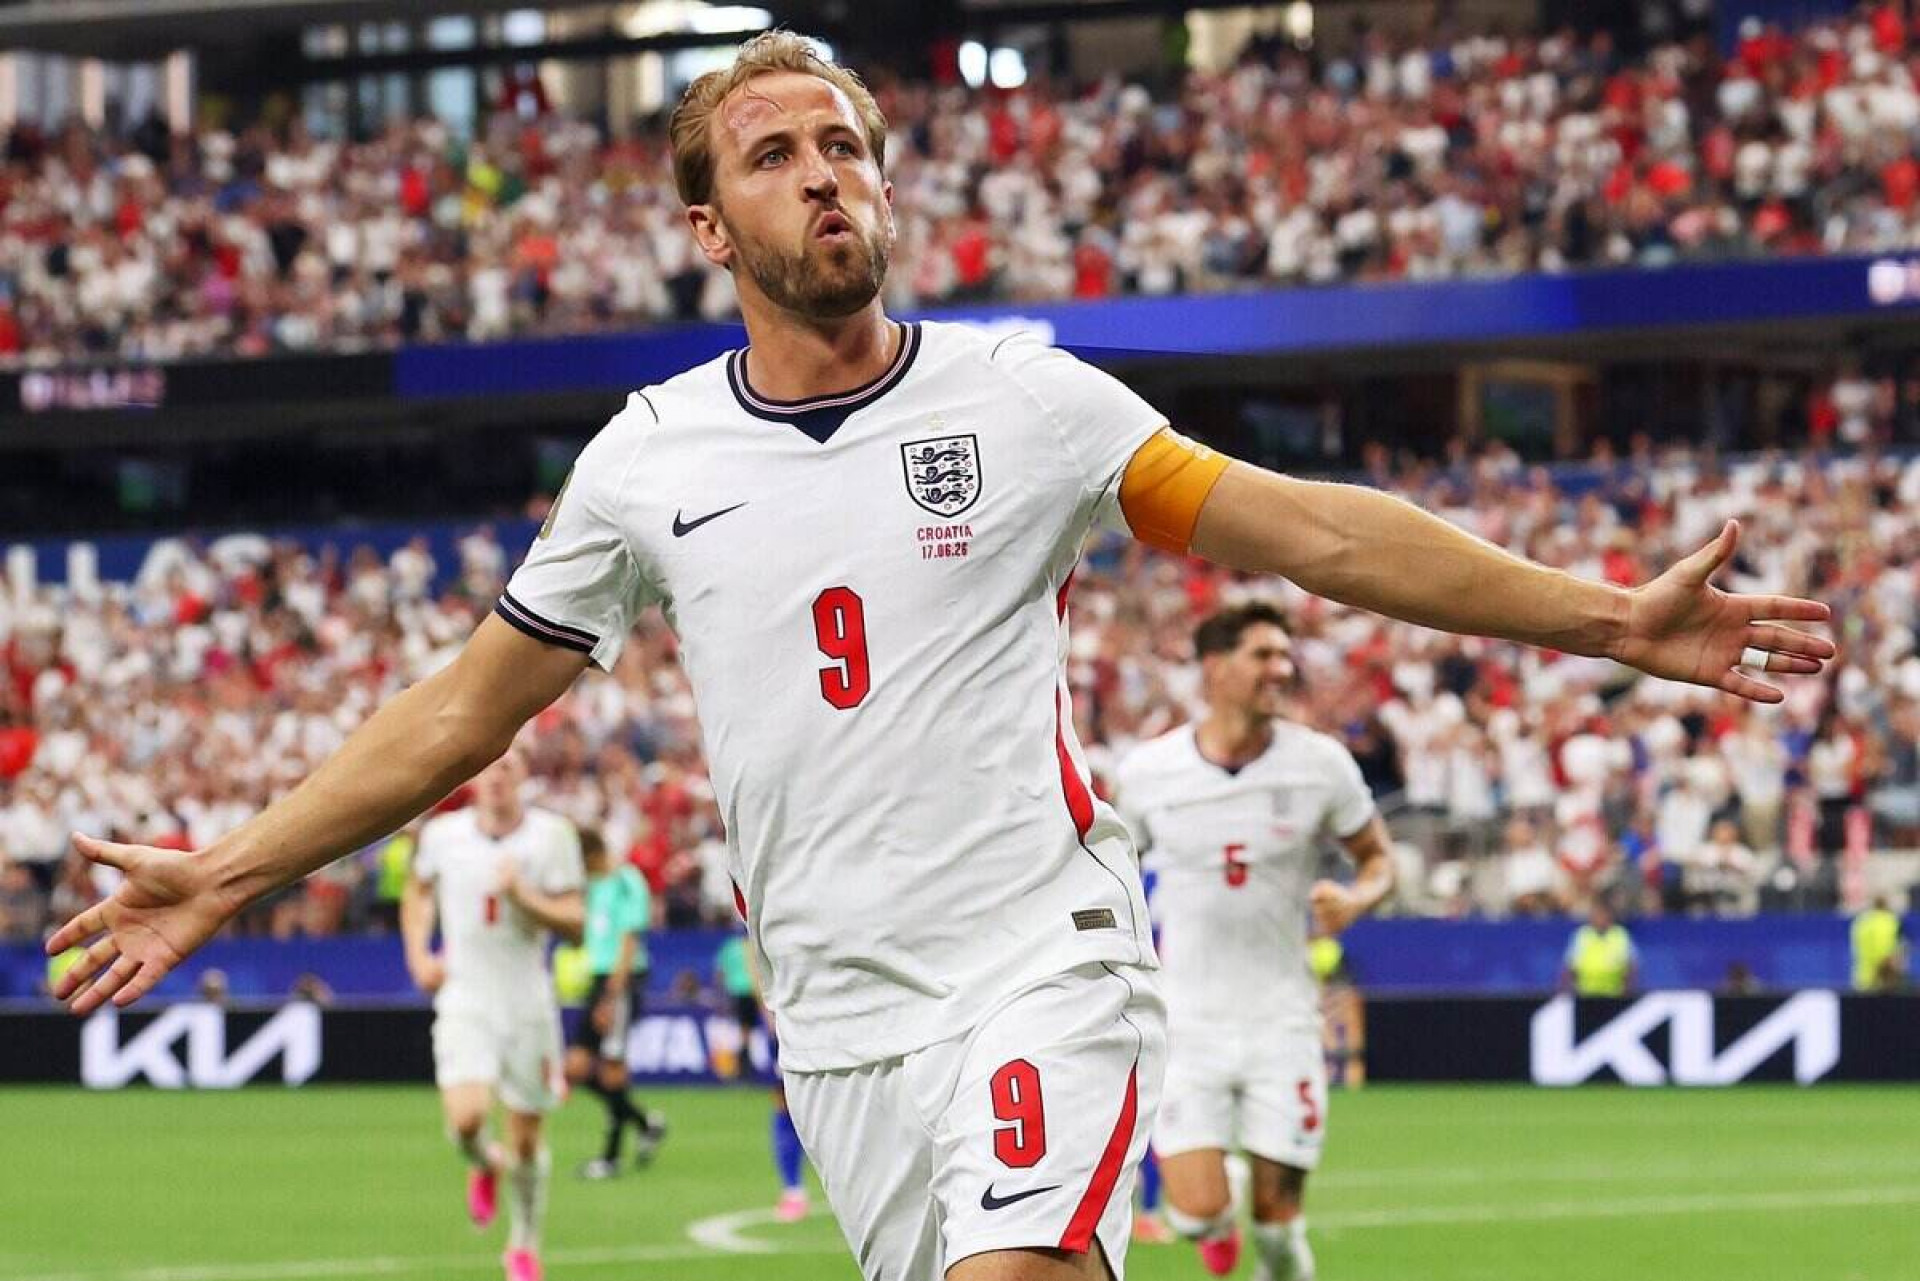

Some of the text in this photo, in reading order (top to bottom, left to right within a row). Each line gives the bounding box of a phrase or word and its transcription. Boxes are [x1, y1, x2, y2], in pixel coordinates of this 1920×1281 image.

[917, 526, 973, 541] CROATIA
[813, 586, 870, 710] 9
[1224, 843, 1248, 888] 5
[80, 1000, 322, 1089] KIA
[1530, 990, 1841, 1086] KIA
[990, 1058, 1046, 1169] 9
[1297, 1080, 1320, 1132] 5
